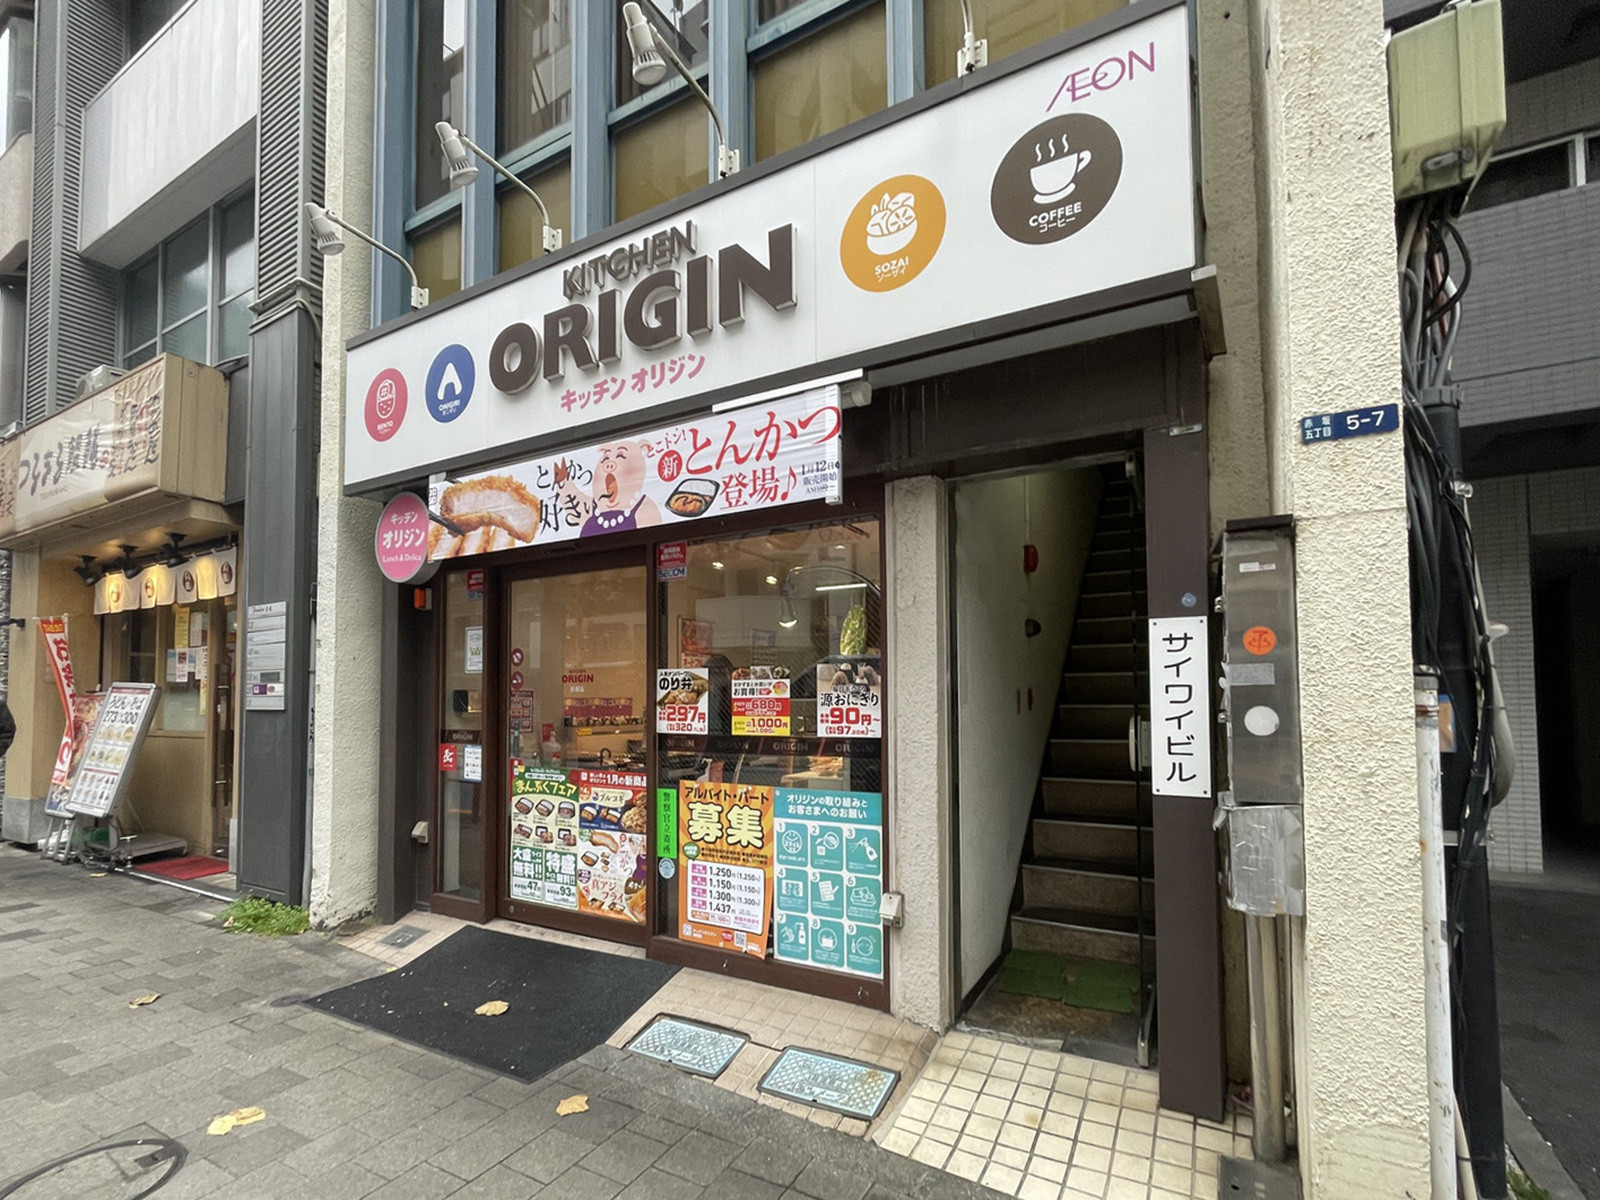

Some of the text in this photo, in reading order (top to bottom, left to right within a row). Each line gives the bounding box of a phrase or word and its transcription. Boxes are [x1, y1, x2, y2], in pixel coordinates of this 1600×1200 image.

[1029, 202, 1082, 228] COFFEE
[1039, 216, 1076, 233] コーヒー
[563, 220, 697, 300] KITCHEN
[874, 256, 910, 275] SOZAI
[489, 223, 797, 394] ORIGIN
[561, 354, 706, 412] キッチン オリジン
[438, 400, 461, 412] ONIGIRI
[377, 420, 395, 431] BENTO
[1346, 410, 1385, 431] 5-7
[686, 406, 841, 476] とんかつ
[1305, 426, 1332, 440] 五丁目
[662, 453, 679, 479] 新
[391, 511, 418, 525] キッチン
[383, 528, 425, 549] オリジン
[562, 674, 594, 683] ORIGIN
[659, 677, 692, 690] のり弁
[820, 693, 879, 707] 源おにぎり
[1163, 632, 1197, 783] サイワイビル
[515, 780, 577, 797] まんぷくフェア
[787, 794, 868, 808] オリジンの取り組みと
[788, 805, 867, 819] お客さまへのお願い
[687, 801, 764, 849] 募集
